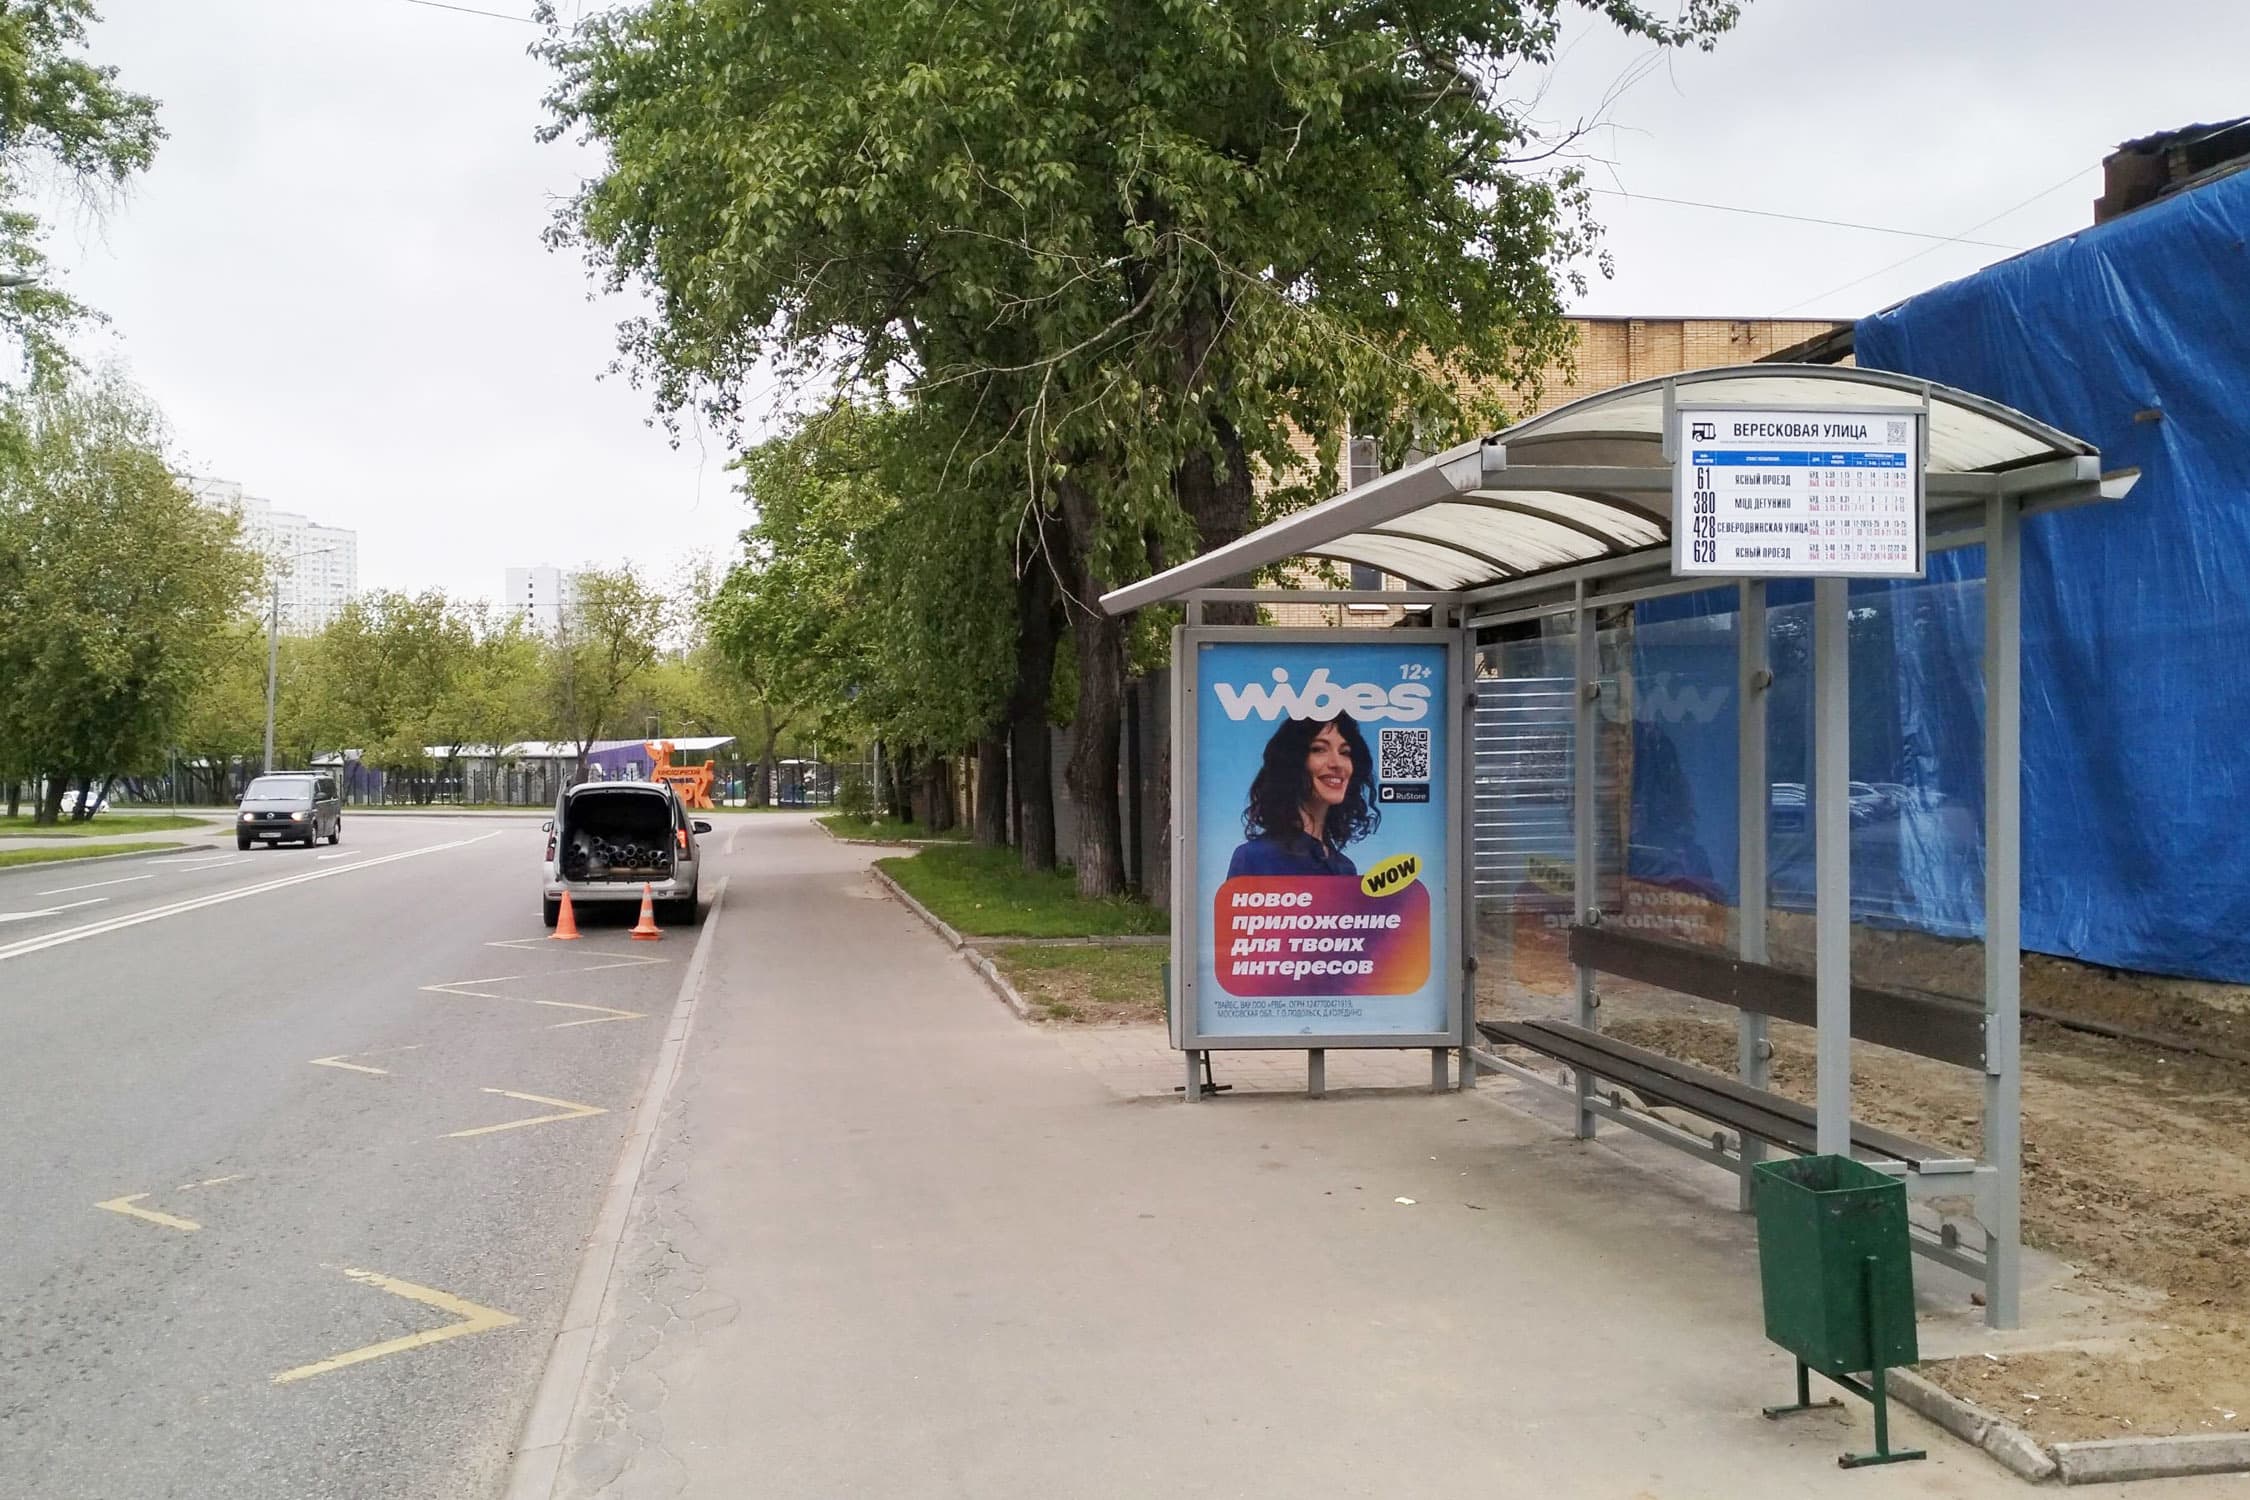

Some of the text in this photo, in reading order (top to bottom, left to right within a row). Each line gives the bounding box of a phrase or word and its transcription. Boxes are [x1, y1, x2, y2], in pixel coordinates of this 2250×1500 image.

[1733, 423, 1868, 440] ВЕРЕСКОВАЯ УЛИЦА
[1697, 466, 1711, 490] 61
[1735, 473, 1791, 487] ЯСНЫЙ ПРОЕЗД
[1693, 491, 1716, 514] 380
[1734, 498, 1792, 510] МЦД ДЕГУНИНО
[1693, 515, 1716, 538] 428
[1717, 521, 1809, 534] СЕВЕРОДВИНСКАЯ УЛИЦА
[1693, 540, 1716, 563] 628
[1735, 546, 1791, 560] ЯСНЫЙ ПРОЕЗД
[1399, 663, 1432, 681] 12+
[1395, 792, 1427, 801] RuStore
[1231, 892, 1313, 908] новое
[1231, 912, 1402, 936] приложение
[1231, 936, 1365, 956] для твоих
[1231, 959, 1374, 981] интересов
